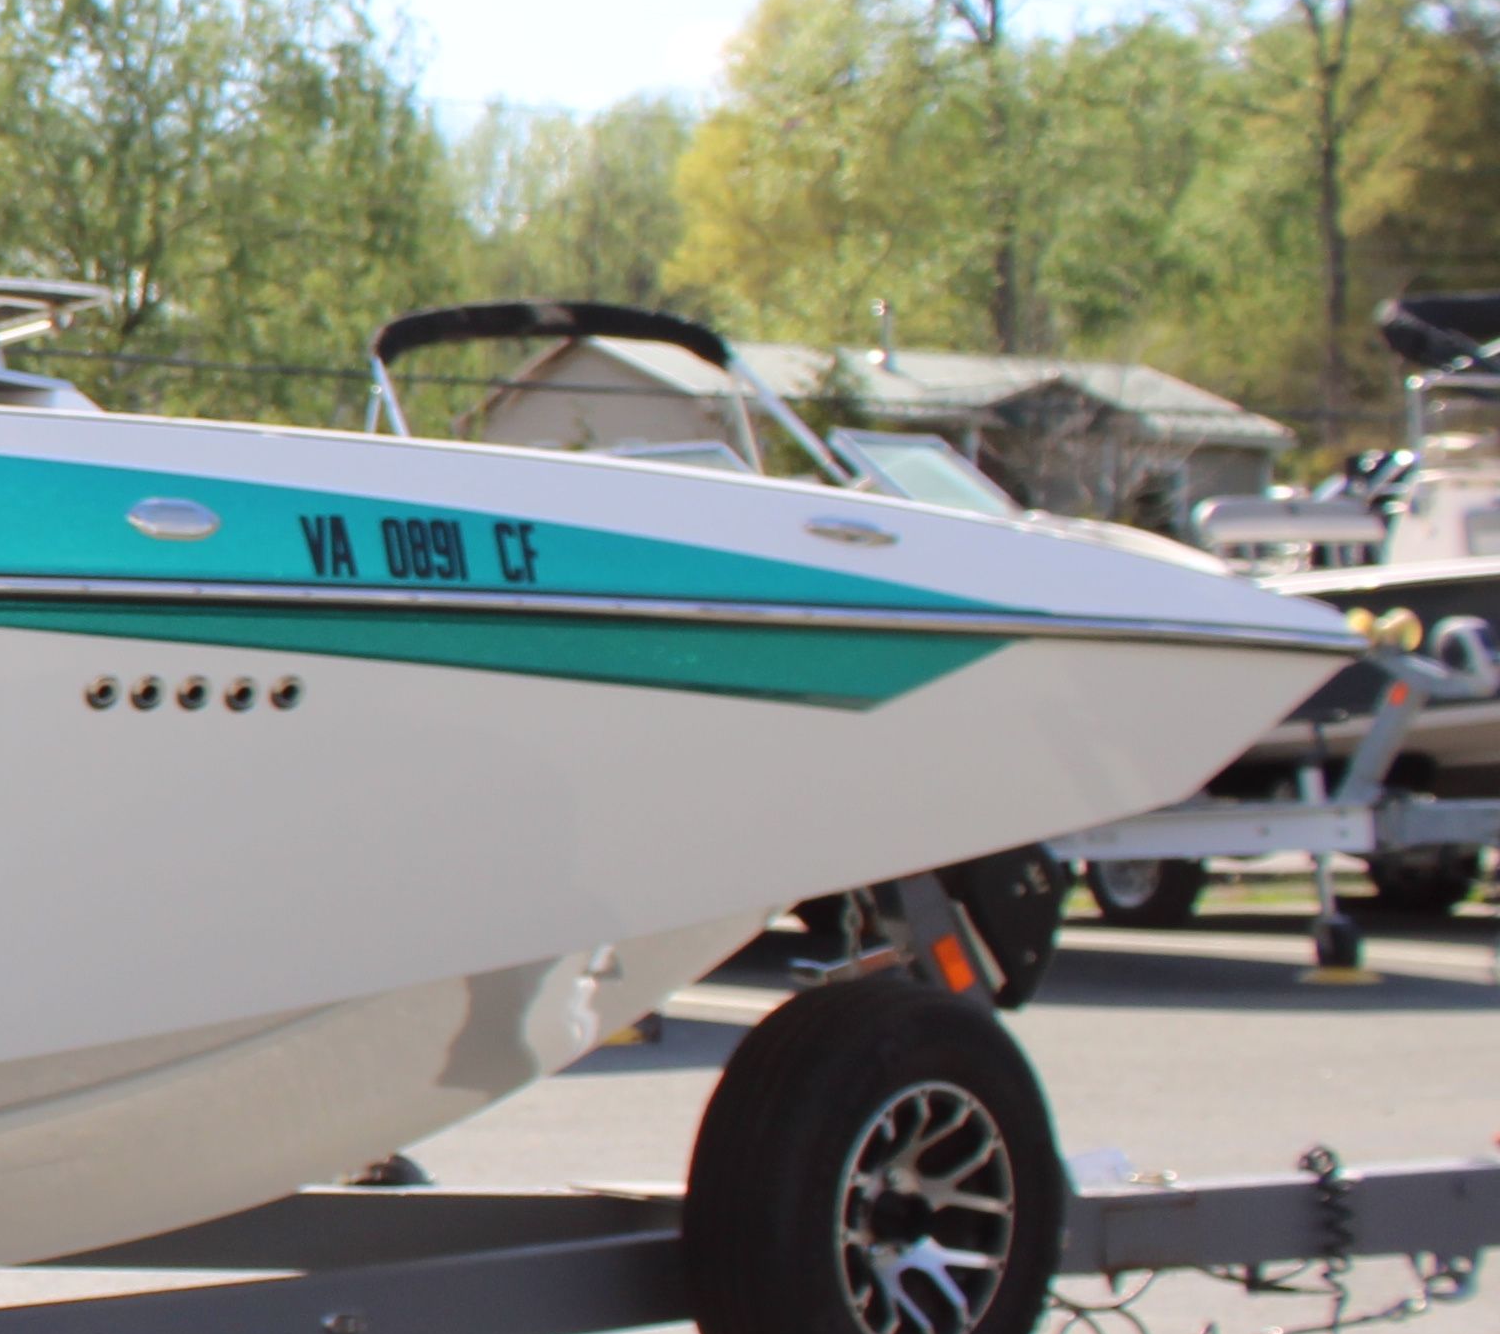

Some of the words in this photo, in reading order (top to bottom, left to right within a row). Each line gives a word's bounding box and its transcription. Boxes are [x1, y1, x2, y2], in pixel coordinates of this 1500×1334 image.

[300, 514, 357, 577] VA
[381, 518, 469, 582] 0891
[494, 522, 538, 584] CF
